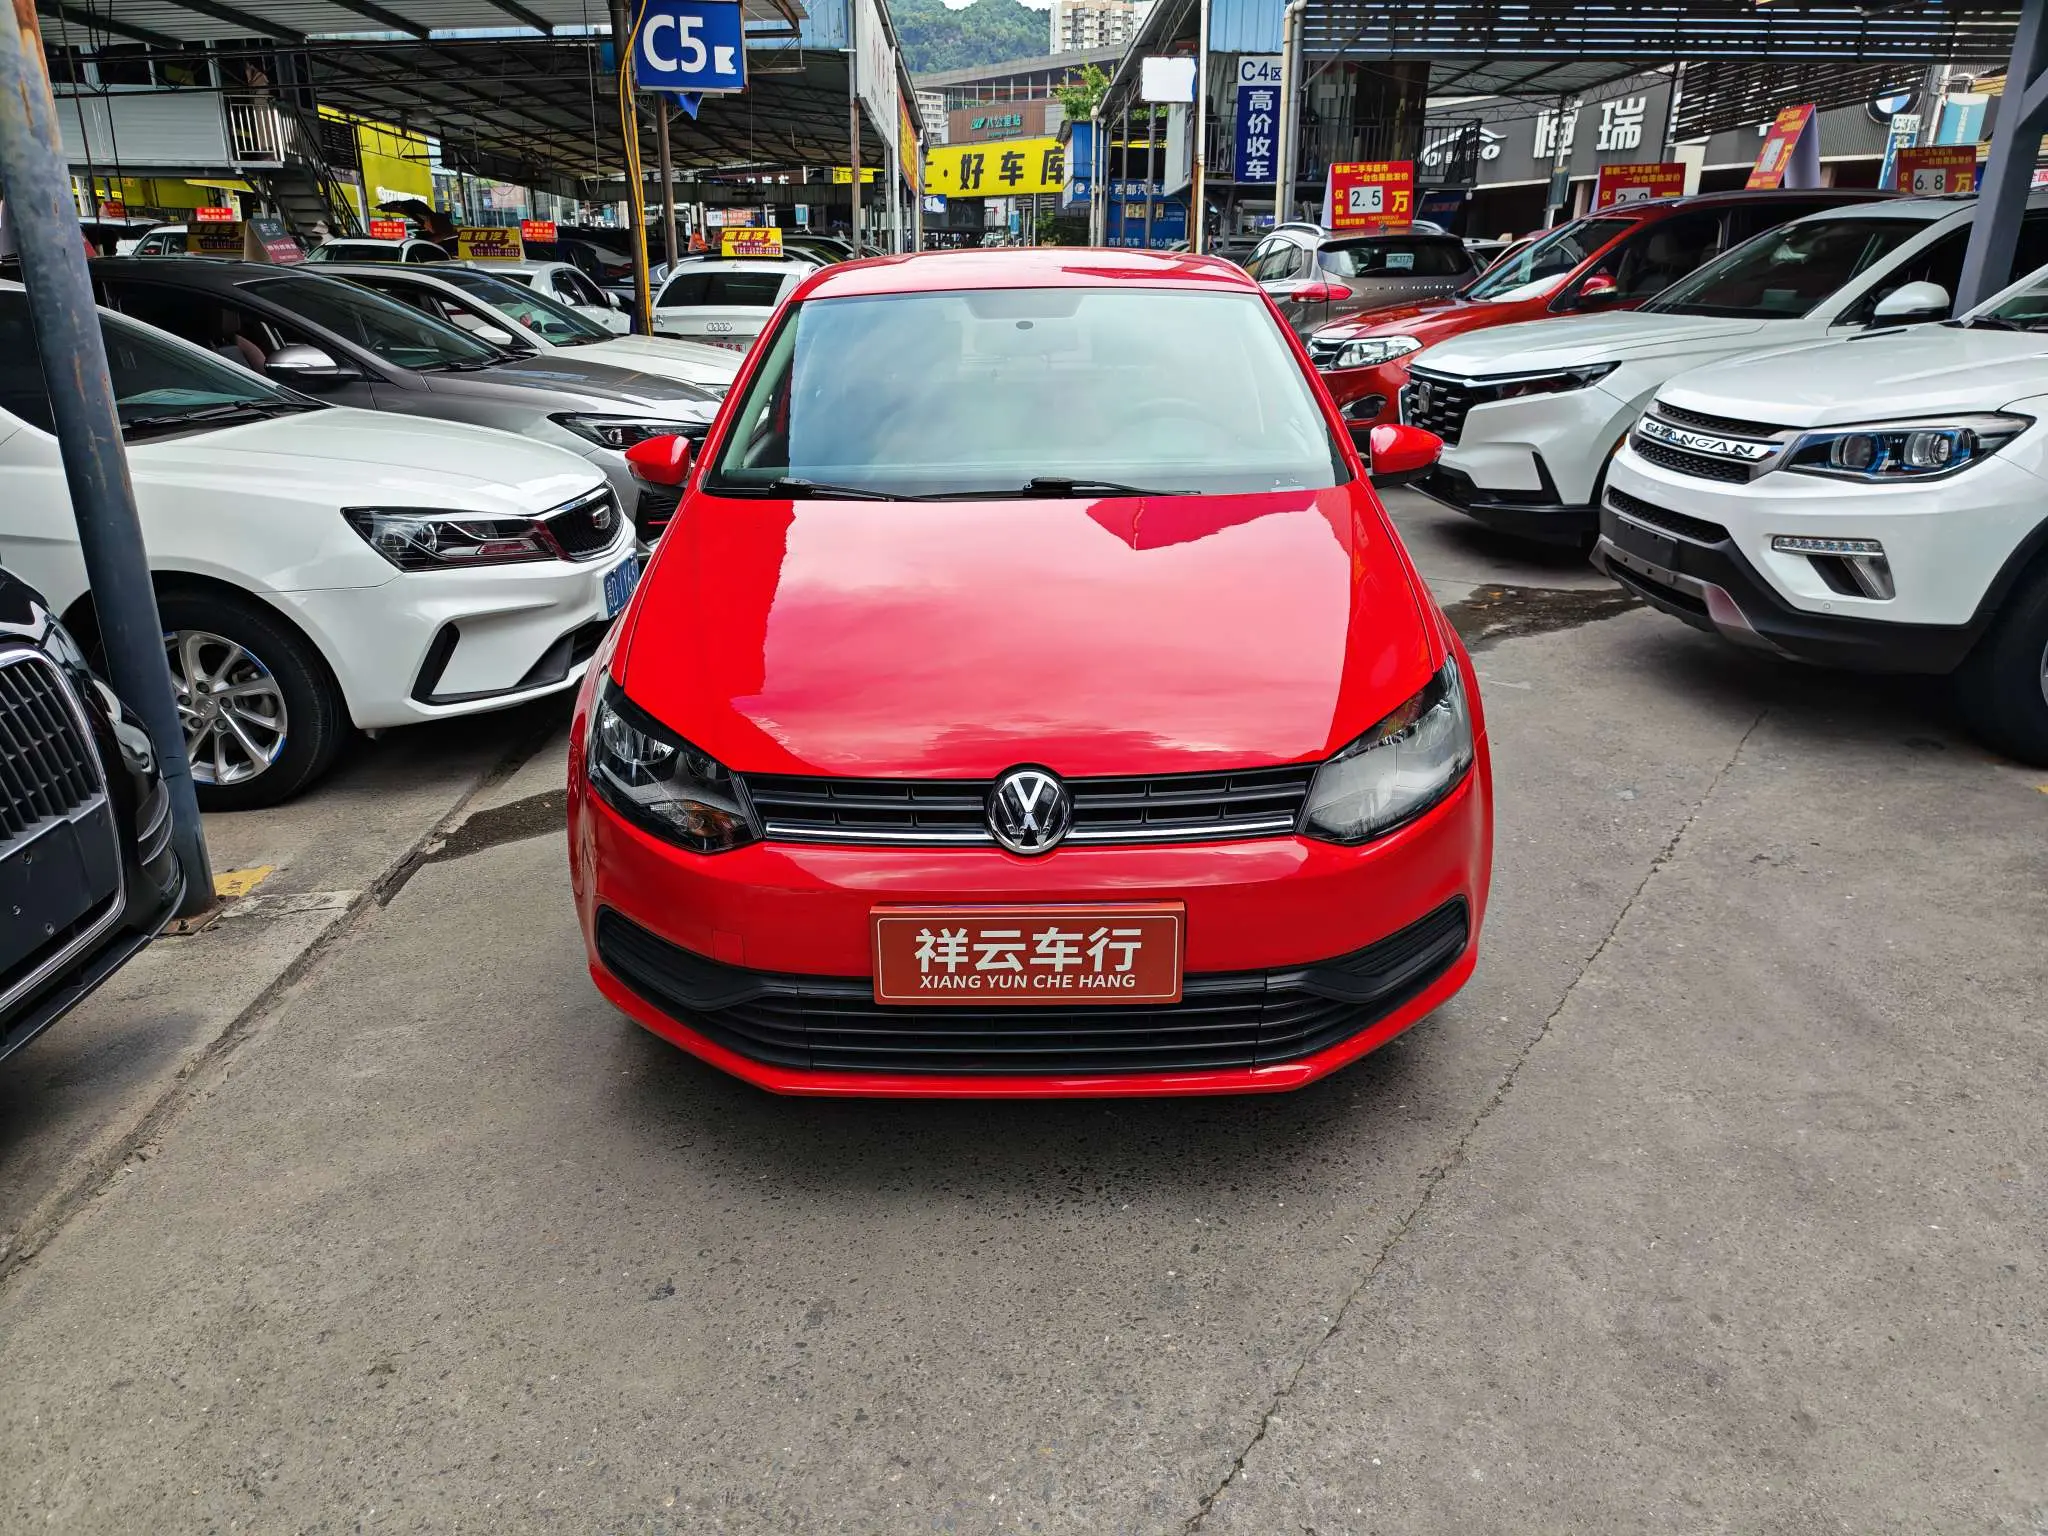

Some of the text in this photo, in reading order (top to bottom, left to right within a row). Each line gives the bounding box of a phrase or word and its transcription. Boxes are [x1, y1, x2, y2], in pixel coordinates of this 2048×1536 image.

[1241, 61, 1282, 81] C4区
[1245, 90, 1274, 179] 高价收车
[1915, 173, 1972, 192] 6.8 万
[1392, 190, 1409, 213] 万
[1645, 422, 1756, 457] CHANGAN
[914, 927, 1142, 973] 祥云车行
[920, 974, 1136, 989] XIANG YUN CHE HANG
